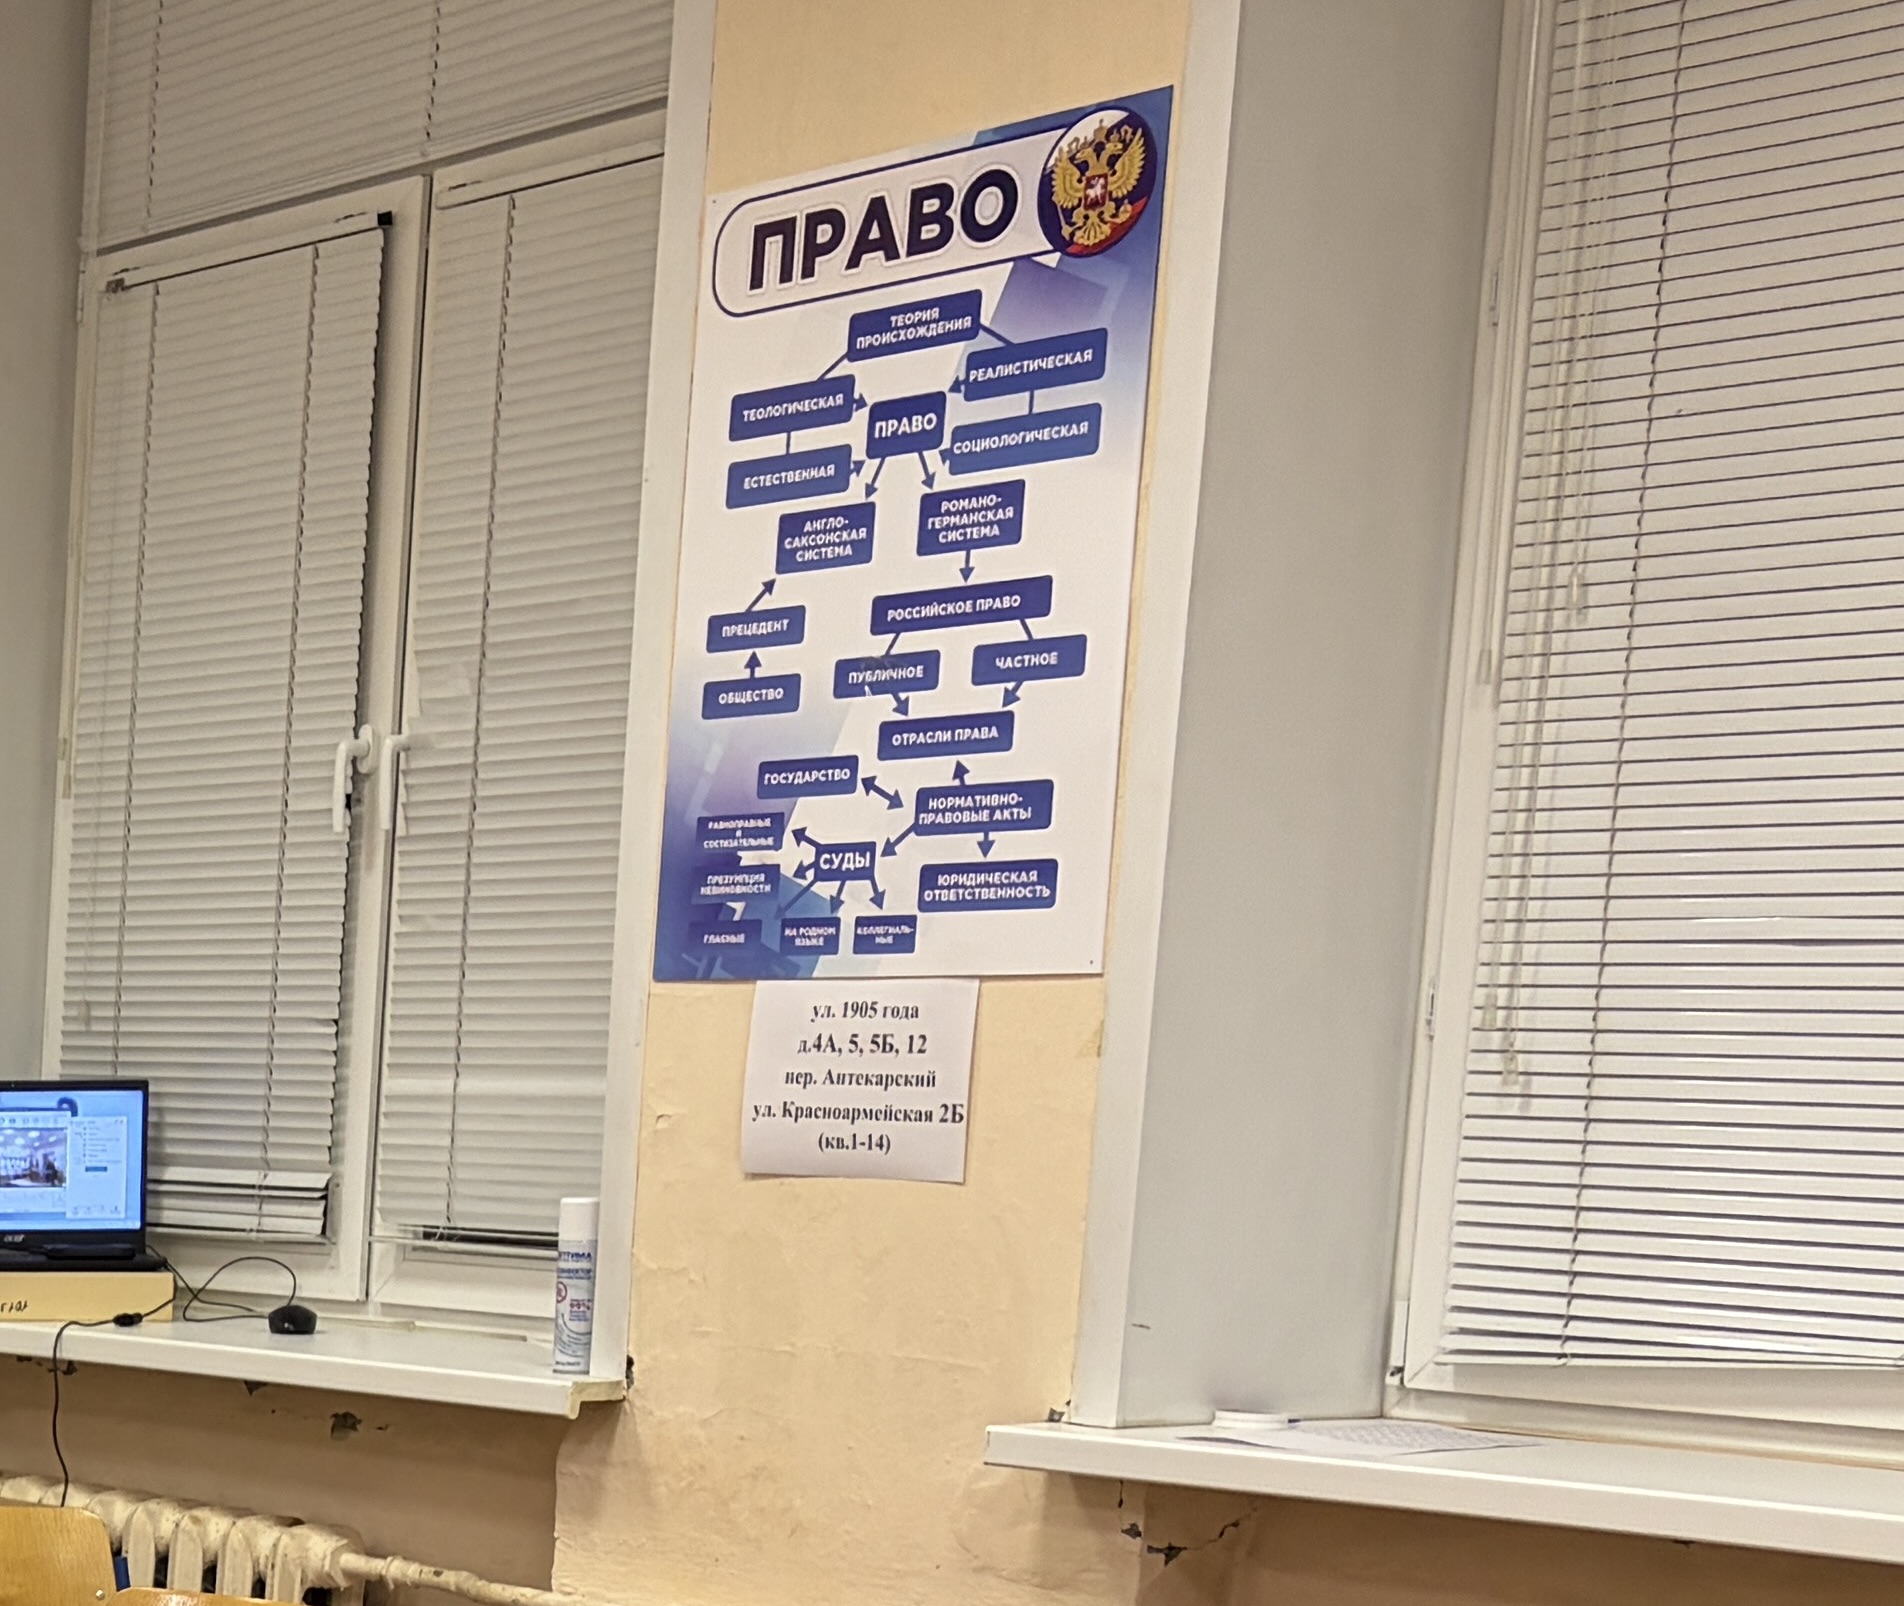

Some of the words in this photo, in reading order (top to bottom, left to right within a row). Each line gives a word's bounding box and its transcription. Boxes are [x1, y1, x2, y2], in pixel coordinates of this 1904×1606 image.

[748, 168, 1019, 292] ПРАВО
[890, 307, 940, 329] ТЕОРИЯ
[856, 316, 972, 350] ПРОИСХОЖДЕНИЯ
[969, 349, 1093, 382] РЕАЛИСТИЧЕСКАЯ
[742, 393, 844, 423] ТЕОЛОГИЧЕСКАЯ
[874, 413, 938, 440] ПРАВО
[953, 421, 1089, 455] СОЦИОЛОГИЧЕСКАЯ
[743, 464, 835, 490] ЕСТЕСТВЕННАЯ
[941, 494, 1002, 513] РОМАНО-
[804, 516, 850, 534] АНГЛО-
[927, 507, 1014, 530] ГЕРМАНСКАЯ
[785, 528, 868, 550] САКСОНСКАЯ
[939, 524, 1001, 543] СИСТЕМА
[796, 544, 853, 562] СИСТЕМА
[887, 599, 973, 622] РОССИЙСКОЕ
[976, 593, 1022, 613] ПРАВО
[722, 618, 789, 638] ПРЕЦЕДЕНТ
[995, 651, 1059, 670] ЧАСТНОЕ
[848, 664, 924, 684] ПУБЛИЧНОЕ
[718, 688, 784, 706] ОБЩЕСТВО
[892, 729, 952, 747] ОТРАСЛИ
[954, 726, 999, 743] ПРАВА
[764, 767, 851, 788] ГОСУДАРСТВО
[929, 793, 1024, 811] НОРМАТИВНО-
[919, 807, 990, 826] ПРАВОВЫЕ
[993, 806, 1032, 822] АКТЫ
[819, 851, 870, 870] СУДЫ
[938, 871, 1038, 887] ЮРИДИЧЕСКАЯ
[924, 884, 1050, 901] ОТВЕТСТВЕННОСТЬ
[810, 1003, 836, 1023] ул.
[842, 1001, 878, 1020] 1905
[882, 1003, 919, 1021] года
[797, 1033, 843, 1057] д.4А,
[848, 1033, 865, 1057] 5,
[869, 1033, 900, 1057] 5Б,
[907, 1033, 928, 1055] 12
[785, 1070, 817, 1089] пер.
[822, 1068, 937, 1091] Аптекарский
[752, 1103, 776, 1123] ул.
[782, 1100, 933, 1125] Красноармейская
[938, 1102, 965, 1124] 2Б
[818, 1132, 891, 1156] (кв.1-14)
